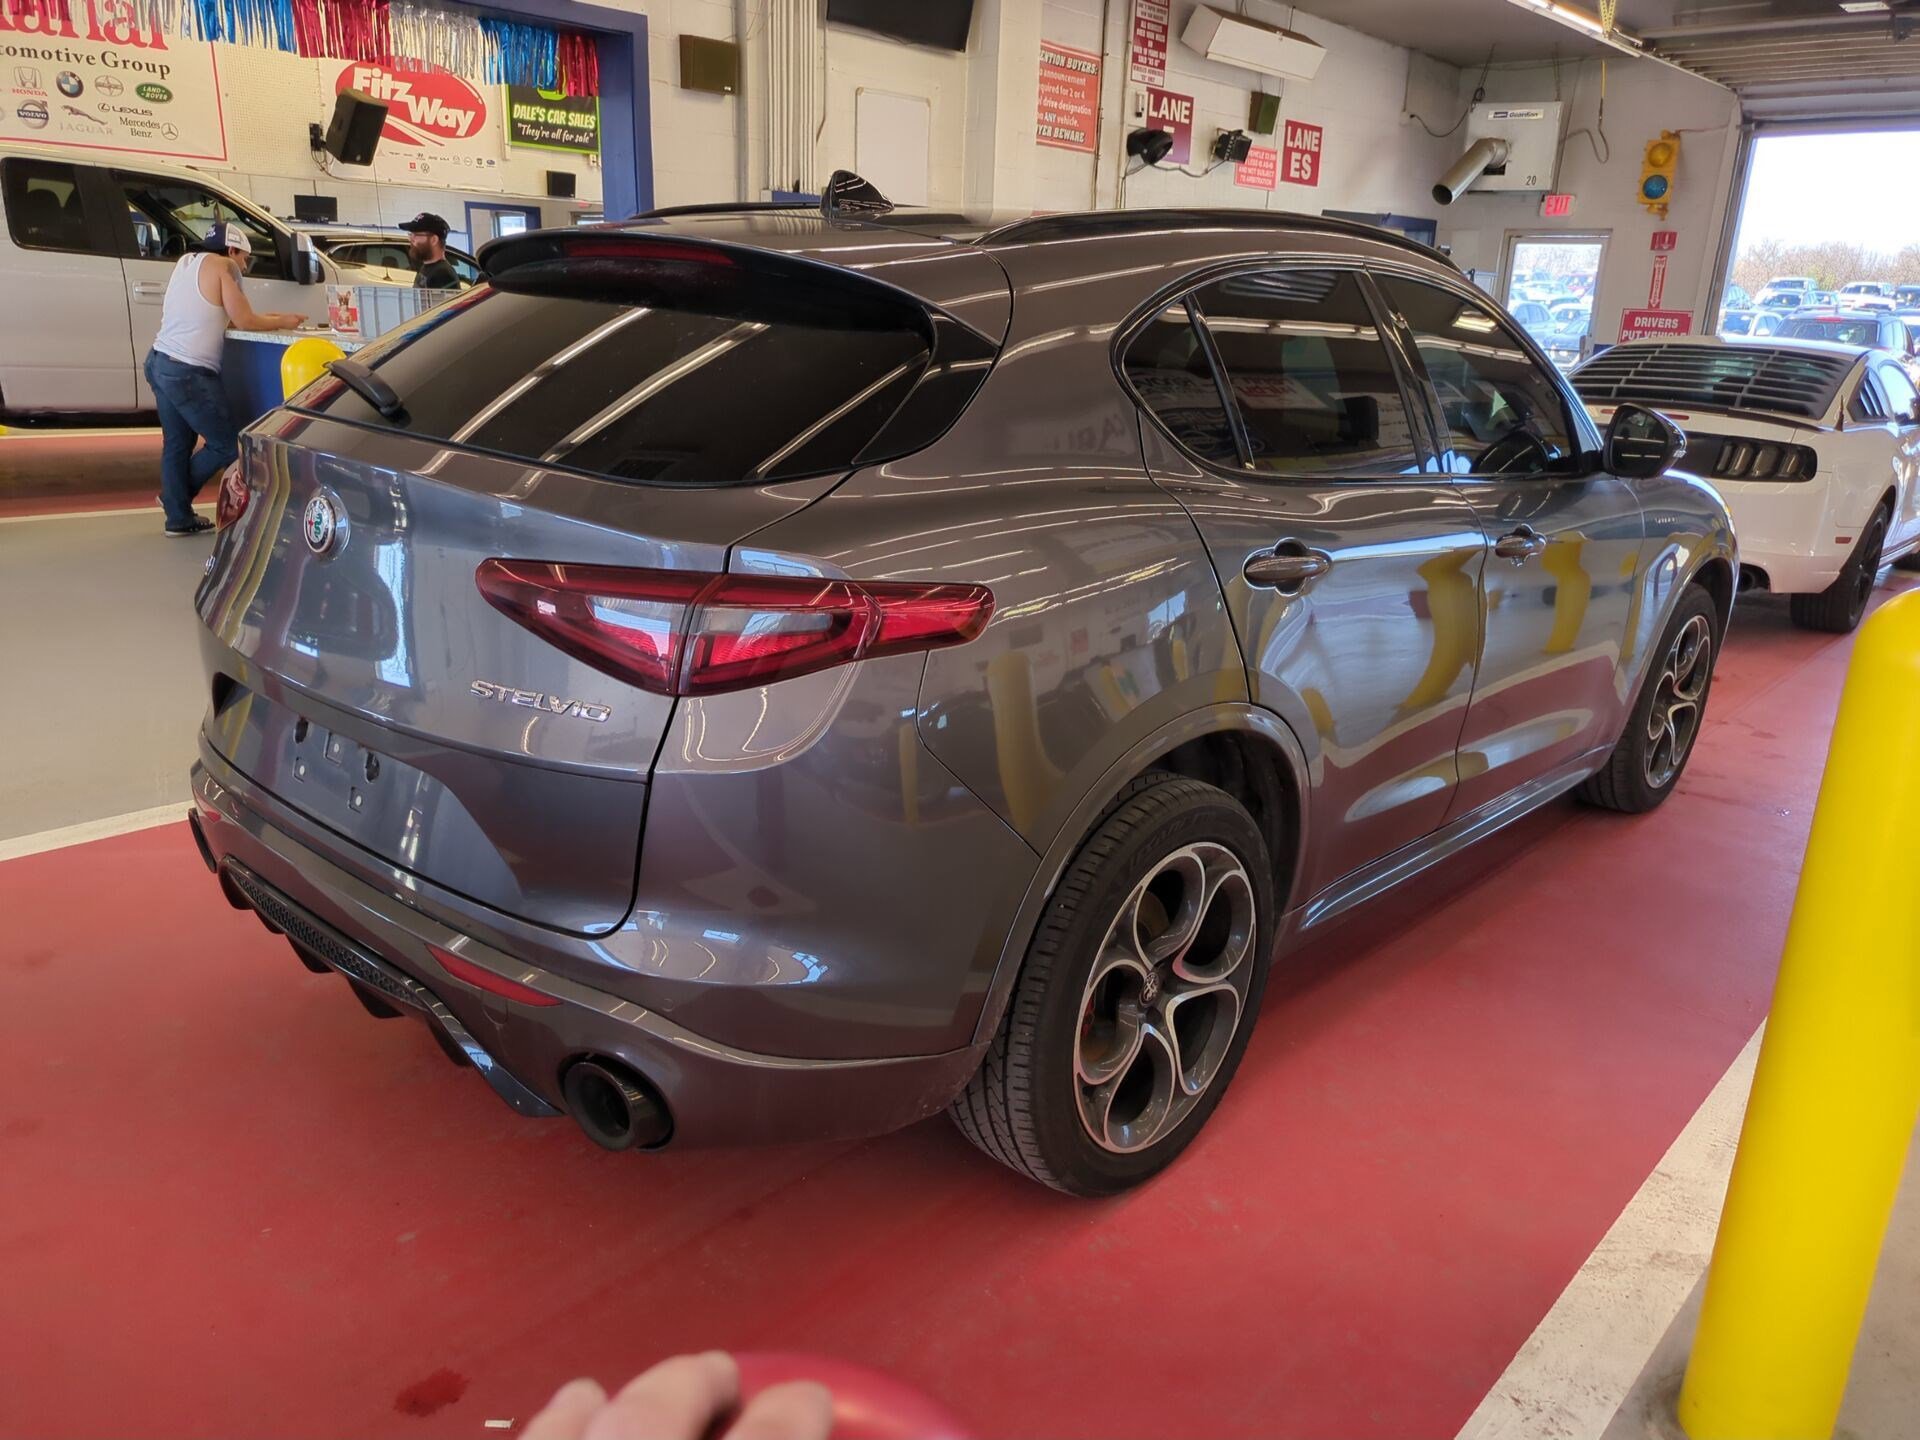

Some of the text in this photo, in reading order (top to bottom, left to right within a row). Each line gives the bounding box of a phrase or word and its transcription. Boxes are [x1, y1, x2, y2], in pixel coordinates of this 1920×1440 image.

[101, 50, 171, 79] Group
[1066, 57, 1098, 75] BUYERS:
[352, 67, 413, 102] Fitz
[1043, 69, 1086, 86] announcement
[12, 88, 48, 97] HONDA
[112, 105, 153, 116] LEXUS
[1043, 96, 1058, 109] drive
[1058, 100, 1091, 116] designation
[1149, 93, 1191, 125] LANE
[18, 111, 47, 119] VOLVO
[119, 117, 160, 129] Mercedes
[407, 96, 476, 137] Way
[513, 104, 596, 129] DALE'S CAR SALES
[1044, 112, 1056, 123] ANY
[60, 122, 113, 135] JAGUAR
[130, 128, 153, 138] Benz
[551, 128, 562, 140] all
[562, 130, 575, 142] for
[1053, 127, 1085, 143] BEWARE
[1287, 126, 1321, 152] LANE
[1289, 151, 1312, 180] ES
[1526, 175, 1537, 186] 20
[1545, 194, 1571, 217] EXIT
[1634, 316, 1679, 329] DRIVERS
[1621, 330, 1643, 340] PUT
[469, 680, 612, 722] STELVIO
